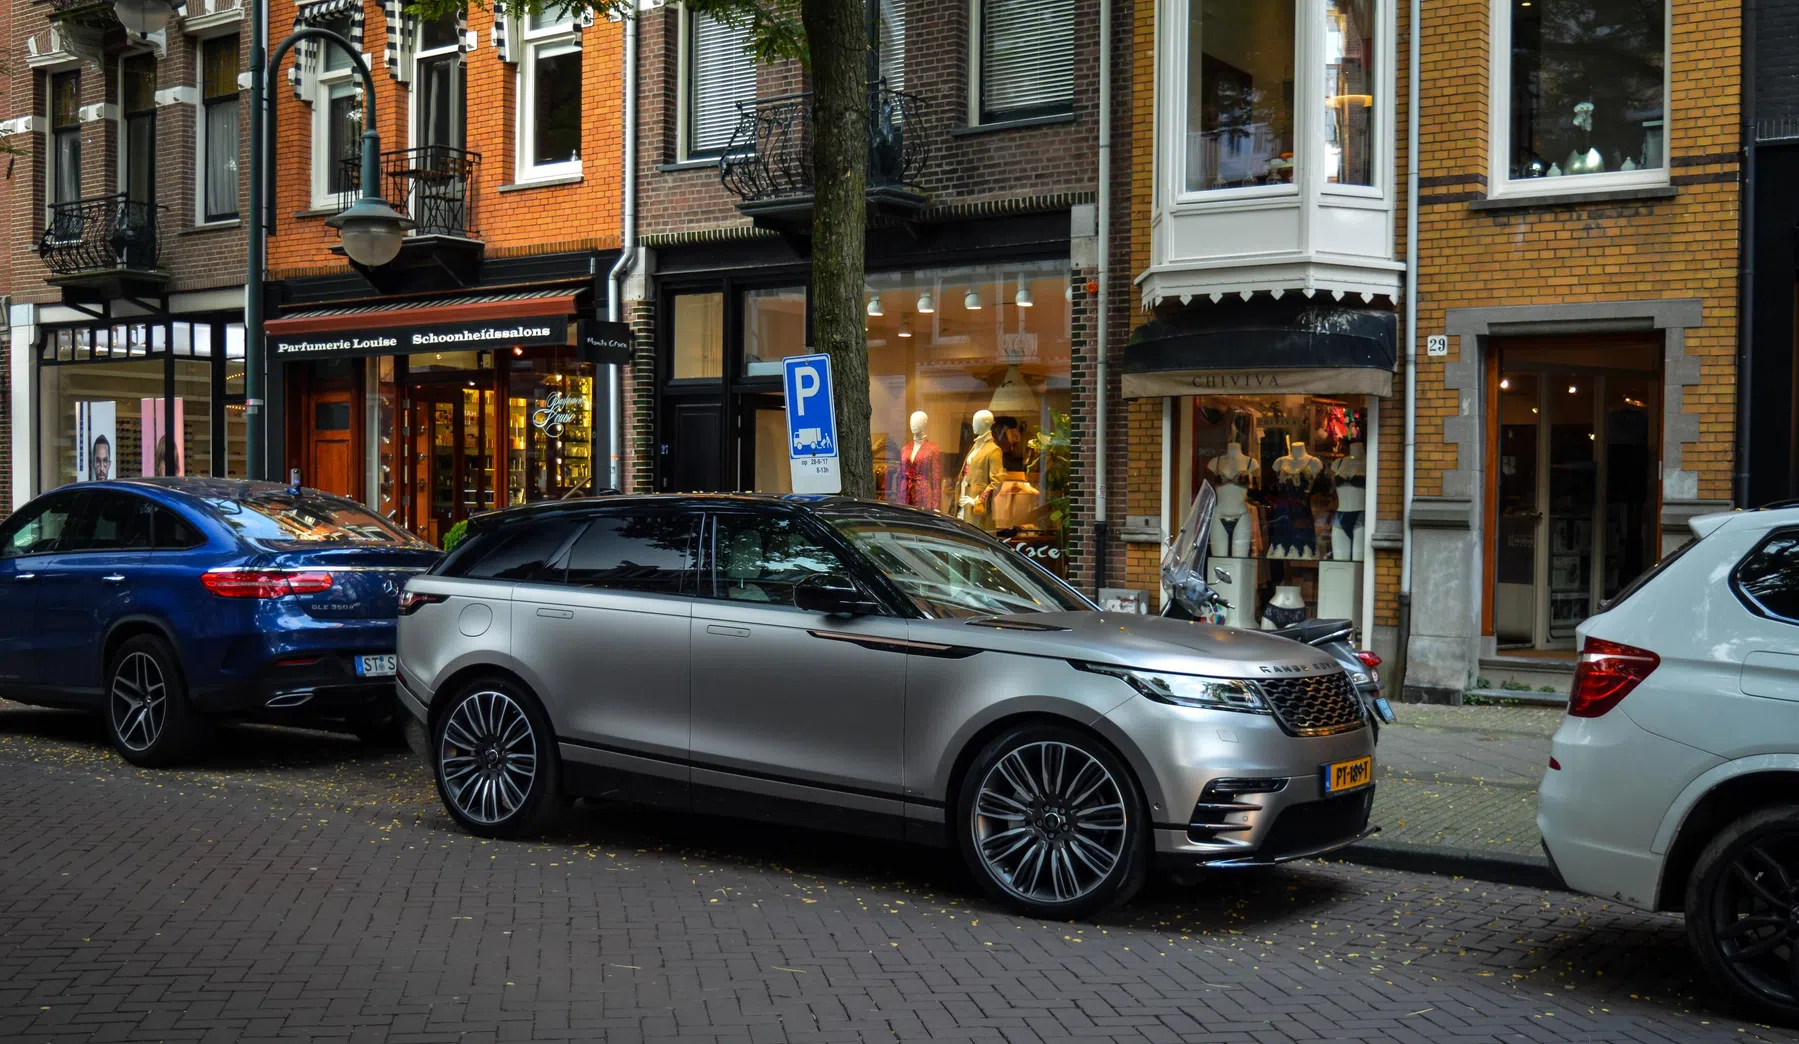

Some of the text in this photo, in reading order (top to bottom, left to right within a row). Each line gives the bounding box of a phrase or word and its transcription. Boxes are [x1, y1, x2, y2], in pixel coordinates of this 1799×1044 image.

[412, 326, 551, 345] Schoonheidssalons
[608, 339, 628, 348] Grace
[277, 336, 398, 353] Parfumerie Louise
[1429, 338, 1446, 352] 29
[1191, 375, 1279, 388] CHIVIVA
[795, 366, 820, 416] P
[364, 656, 396, 672] ST S
[1336, 761, 1369, 786] PT-189-T
